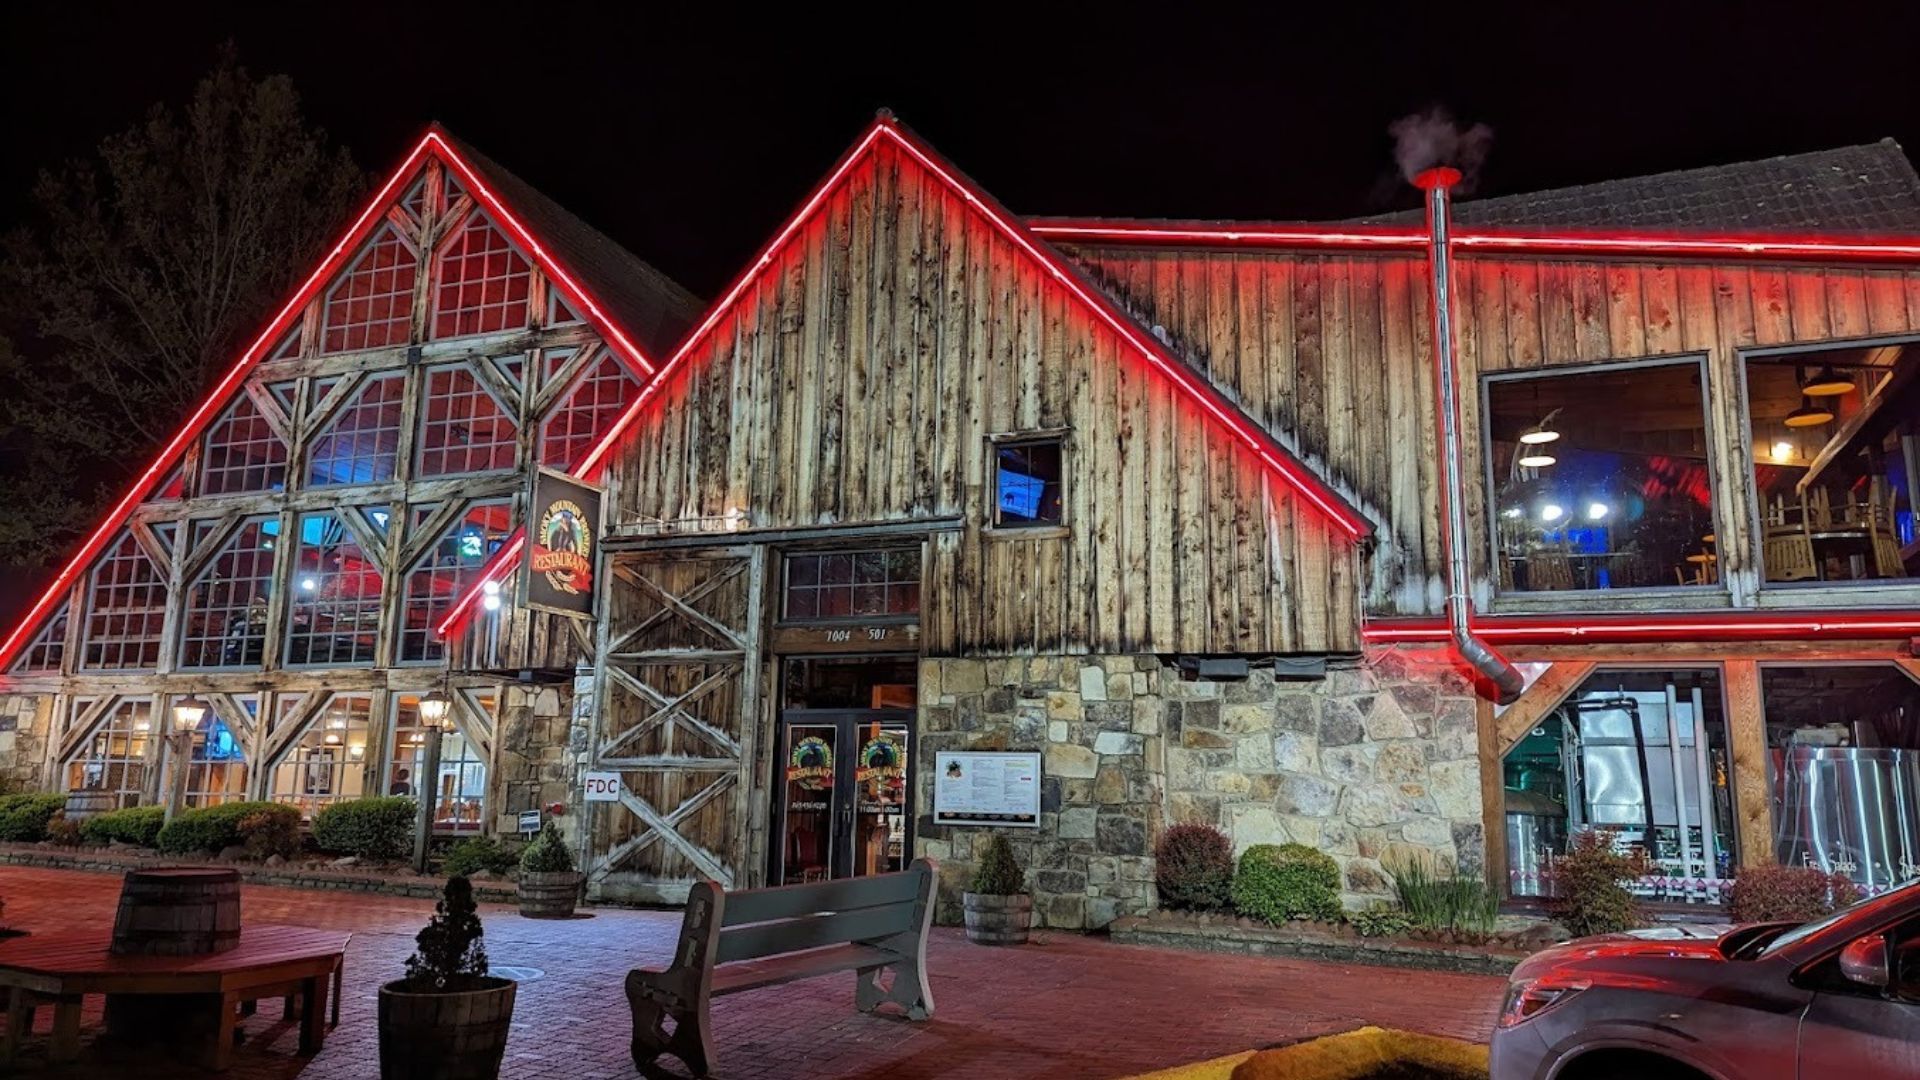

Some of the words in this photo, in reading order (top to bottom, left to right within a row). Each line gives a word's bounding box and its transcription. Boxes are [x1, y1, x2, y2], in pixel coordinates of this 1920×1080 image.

[534, 553, 590, 575] RESTAURANT
[868, 628, 886, 640] 501
[586, 779, 618, 794] FDC
[1828, 851, 1857, 875] Salads
